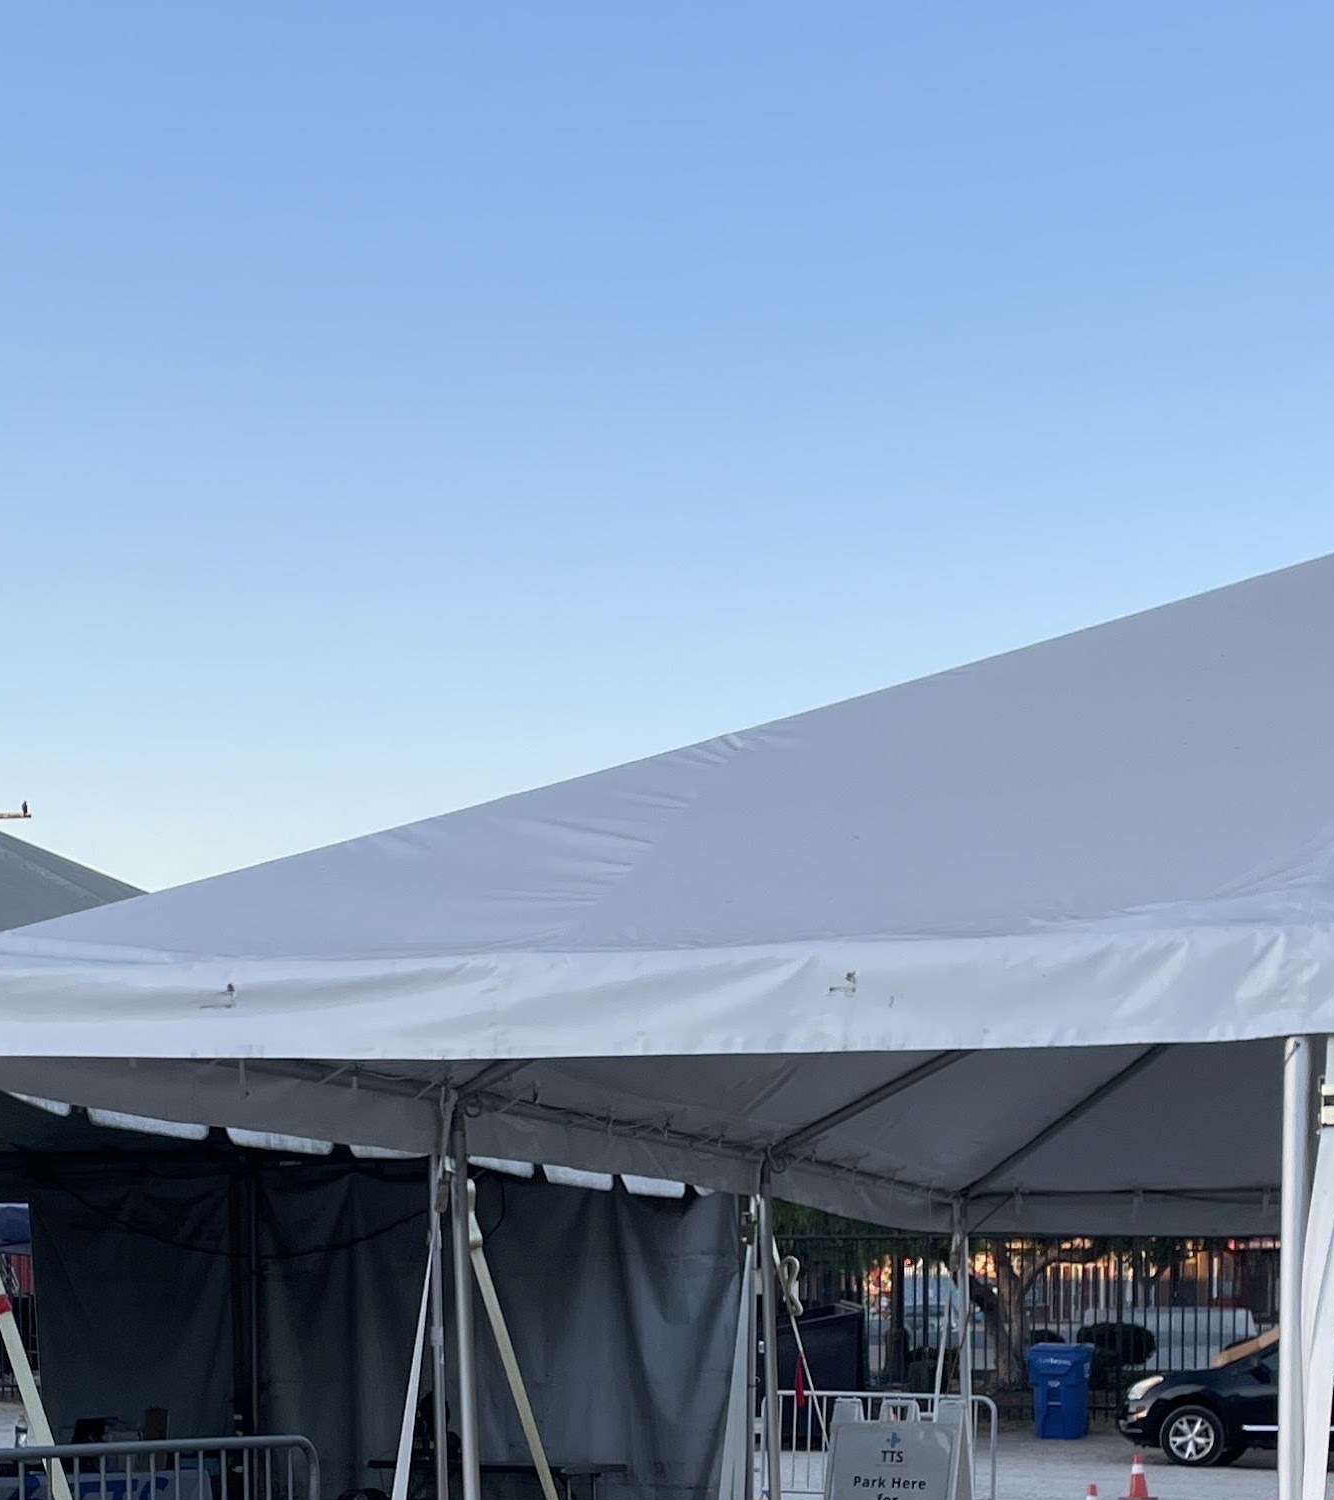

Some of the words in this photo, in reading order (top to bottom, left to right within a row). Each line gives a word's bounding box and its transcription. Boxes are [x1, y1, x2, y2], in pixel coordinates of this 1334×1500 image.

[881, 1450, 904, 1463] TTS
[854, 1475, 886, 1489] Park
[891, 1476, 927, 1490] Here
